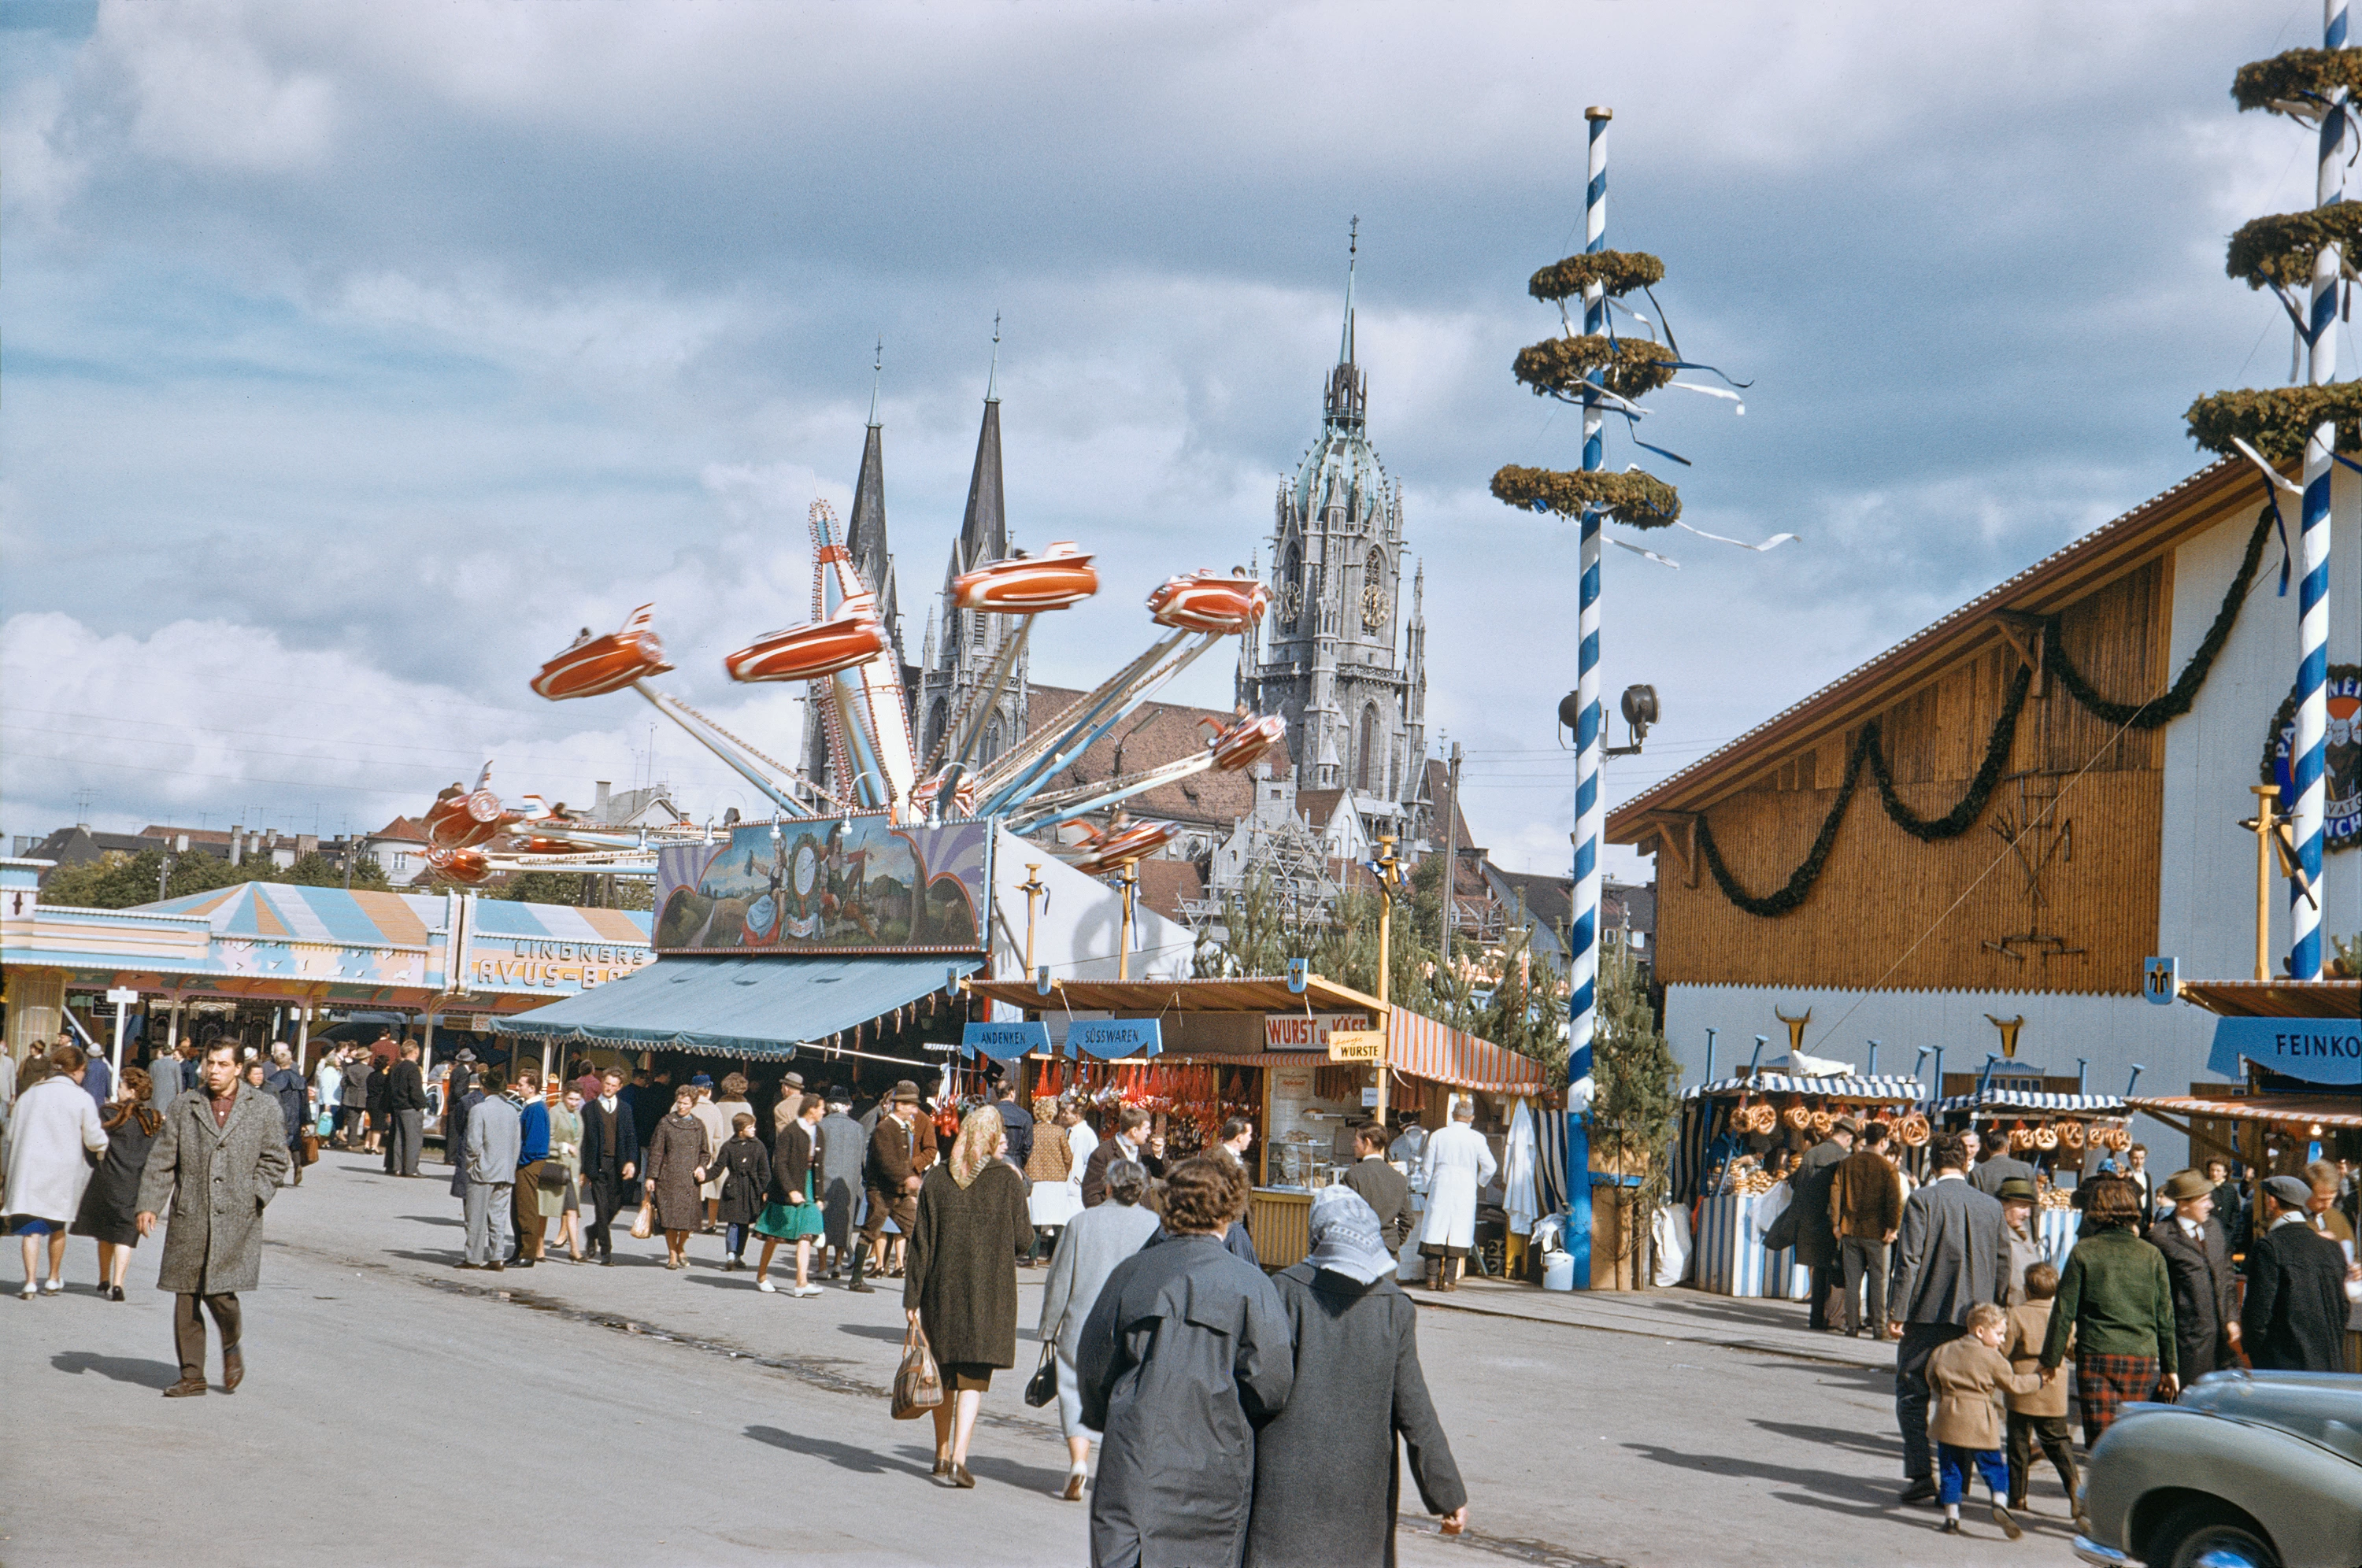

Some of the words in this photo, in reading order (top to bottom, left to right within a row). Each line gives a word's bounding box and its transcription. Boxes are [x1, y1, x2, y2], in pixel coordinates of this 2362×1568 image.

[515, 941, 644, 964] LINDNERS
[478, 959, 636, 989] AVUS-BA
[981, 1031, 1026, 1045] ANDENKEN
[1085, 1027, 1139, 1044] SÜSSWAREN
[1267, 1019, 1317, 1044] WURST
[1341, 1043, 1379, 1057] WÜRSTE
[2275, 1034, 2361, 1058] FEINKO
